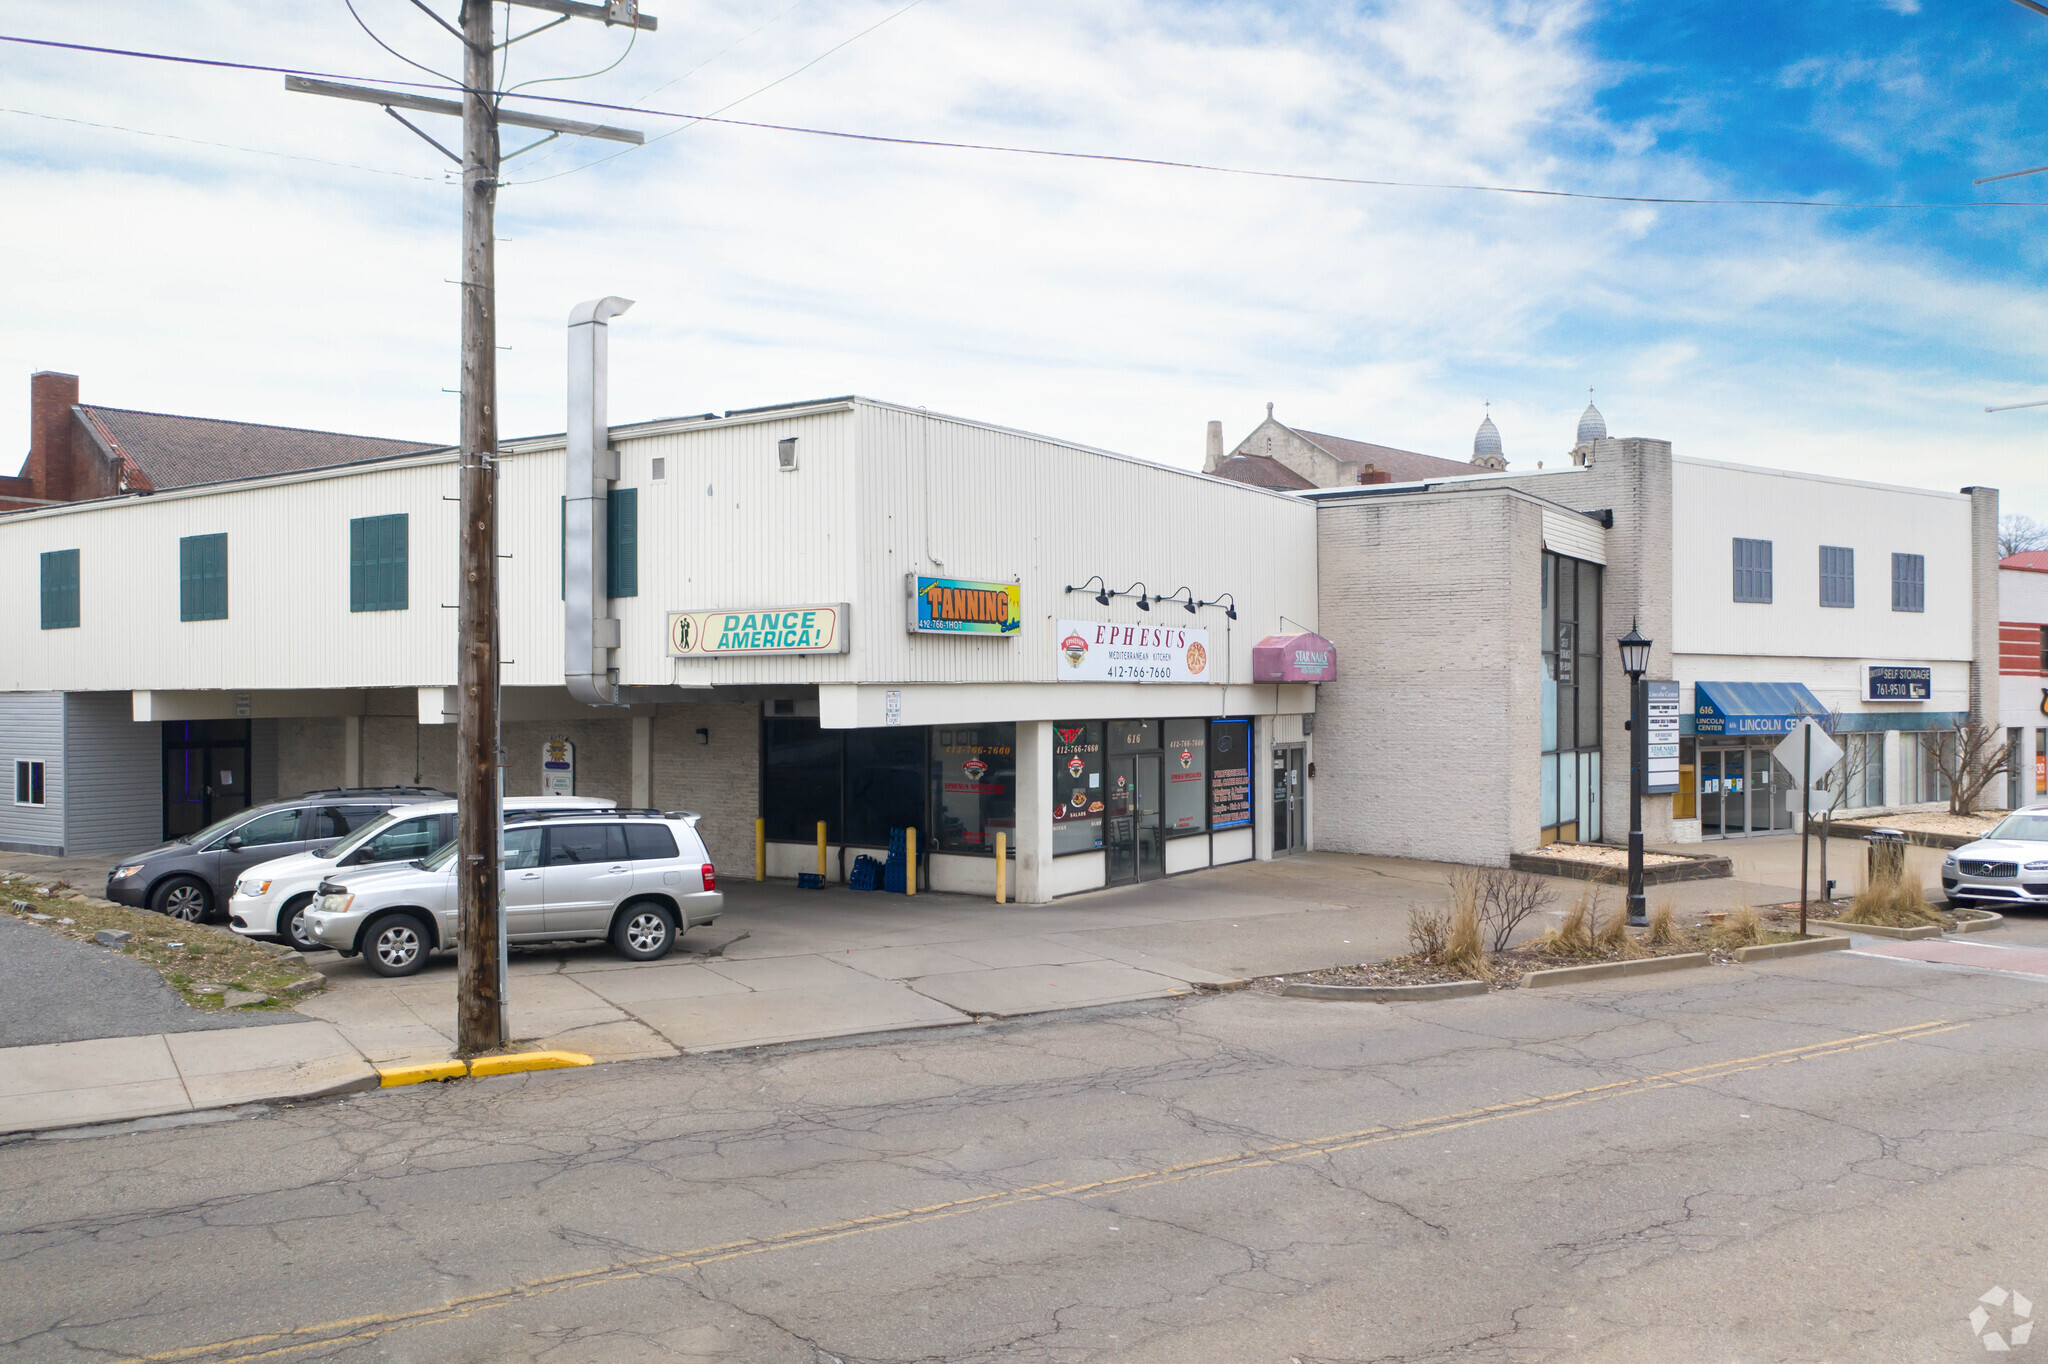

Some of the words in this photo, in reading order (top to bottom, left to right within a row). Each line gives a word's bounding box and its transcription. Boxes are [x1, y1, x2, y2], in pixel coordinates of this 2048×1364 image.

[927, 587, 1009, 624] TANNING
[722, 611, 817, 632] DANCE
[918, 619, 963, 630] 412-766-1HOT
[717, 629, 821, 649] AMERICA!
[1095, 625, 1186, 649] EPHESUS
[1108, 650, 1149, 662] MEDITERRANEAN
[1152, 652, 1171, 662] KITCHEN
[1295, 650, 1310, 663] STAR
[1311, 651, 1328, 663] NAILS
[1107, 666, 1171, 678] 412-766-7660
[1883, 669, 1898, 680] SELF
[1899, 669, 1930, 680] STORAGE
[1876, 683, 1906, 696] 761-9510
[1699, 706, 1714, 715] 616
[1695, 717, 1725, 726] LINCOLN
[1739, 718, 1782, 731] LINCOLN
[1697, 724, 1723, 732] CENTER
[1127, 733, 1141, 744] 616
[1069, 811, 1087, 819] SALADS
